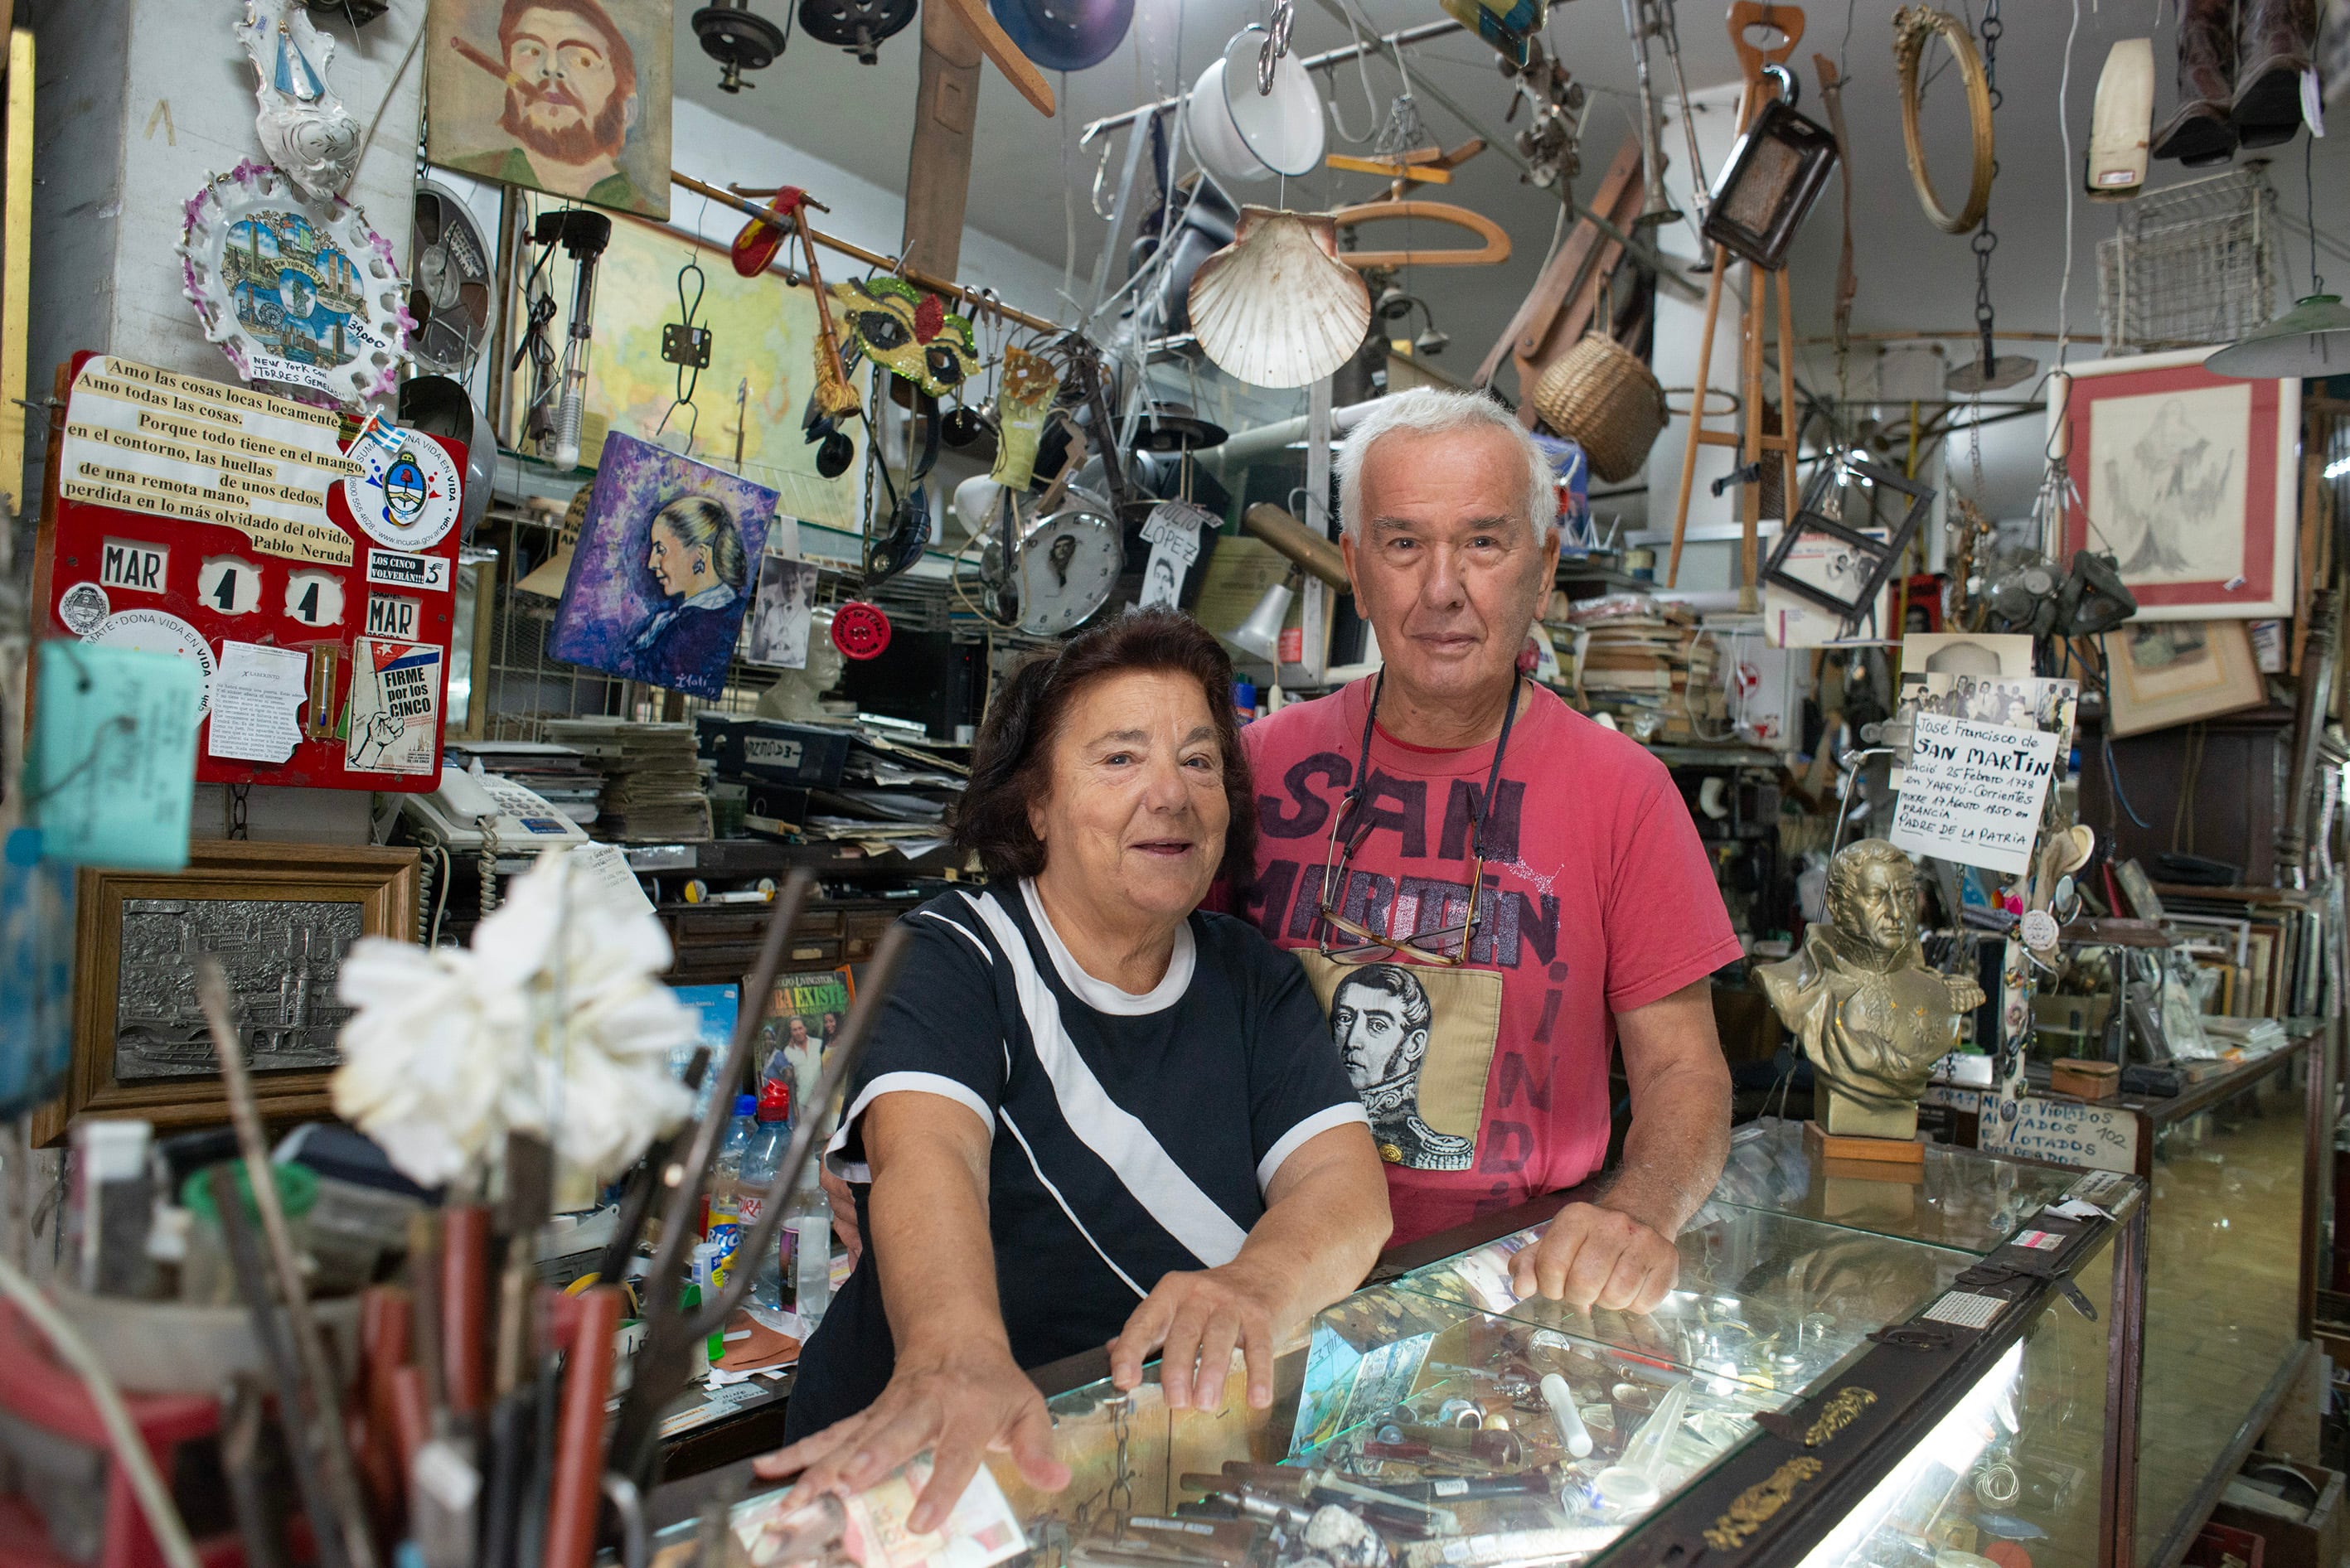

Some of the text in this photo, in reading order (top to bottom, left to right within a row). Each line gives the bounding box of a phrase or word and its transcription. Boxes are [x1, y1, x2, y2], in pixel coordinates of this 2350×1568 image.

[272, 259, 322, 281] NEW YORK CITY
[348, 319, 385, 349] 39,000
[254, 356, 279, 367] NEW
[79, 373, 243, 424] Amo todas las cosas.
[109, 361, 149, 380] Amo
[155, 370, 177, 388] las
[182, 380, 222, 399] cosas
[226, 389, 263, 409] locas
[268, 399, 342, 428] locamente.
[68, 425, 273, 477] en el contorno, las huellas
[139, 414, 366, 476] Porque todo tiene en el mango,
[422, 439, 442, 458] VIDA
[439, 460, 451, 473] EN
[447, 475, 456, 501] VIDA
[80, 462, 250, 508] de una remota mano,
[220, 474, 323, 508] de unos dedos,
[65, 482, 353, 547] perdida en lo más olvidado del olvido.
[352, 497, 364, 513] 555
[360, 512, 376, 530] 4628
[1156, 503, 1199, 532] JULIO
[252, 535, 351, 564] Pablo Neruda
[372, 555, 415, 570] LOS CINCO
[104, 546, 161, 589] MAR
[371, 568, 424, 583] VOLVERÁN!!!
[370, 599, 413, 635] MAR
[119, 614, 156, 625] DONA
[158, 617, 184, 636] VIDA
[184, 632, 199, 647] EN
[196, 648, 211, 677] VIDA
[384, 667, 425, 688] FIRME
[387, 684, 428, 703] por los
[390, 698, 431, 718] CINCO
[1916, 718, 2039, 748] José Francisco de
[1913, 738, 1958, 761] SAN
[1904, 776, 1921, 786] en
[1946, 766, 1963, 777] 25
[1963, 767, 2004, 784] Febrero
[2007, 777, 2034, 789] 1778
[1258, 751, 1527, 864] SAN
[1932, 795, 1945, 806] 17
[1984, 805, 2013, 817] 1850
[1898, 812, 1936, 833] PADRE
[1939, 824, 1958, 835] DE
[1960, 828, 1974, 840] LA
[2095, 1126, 2127, 1150] 102
